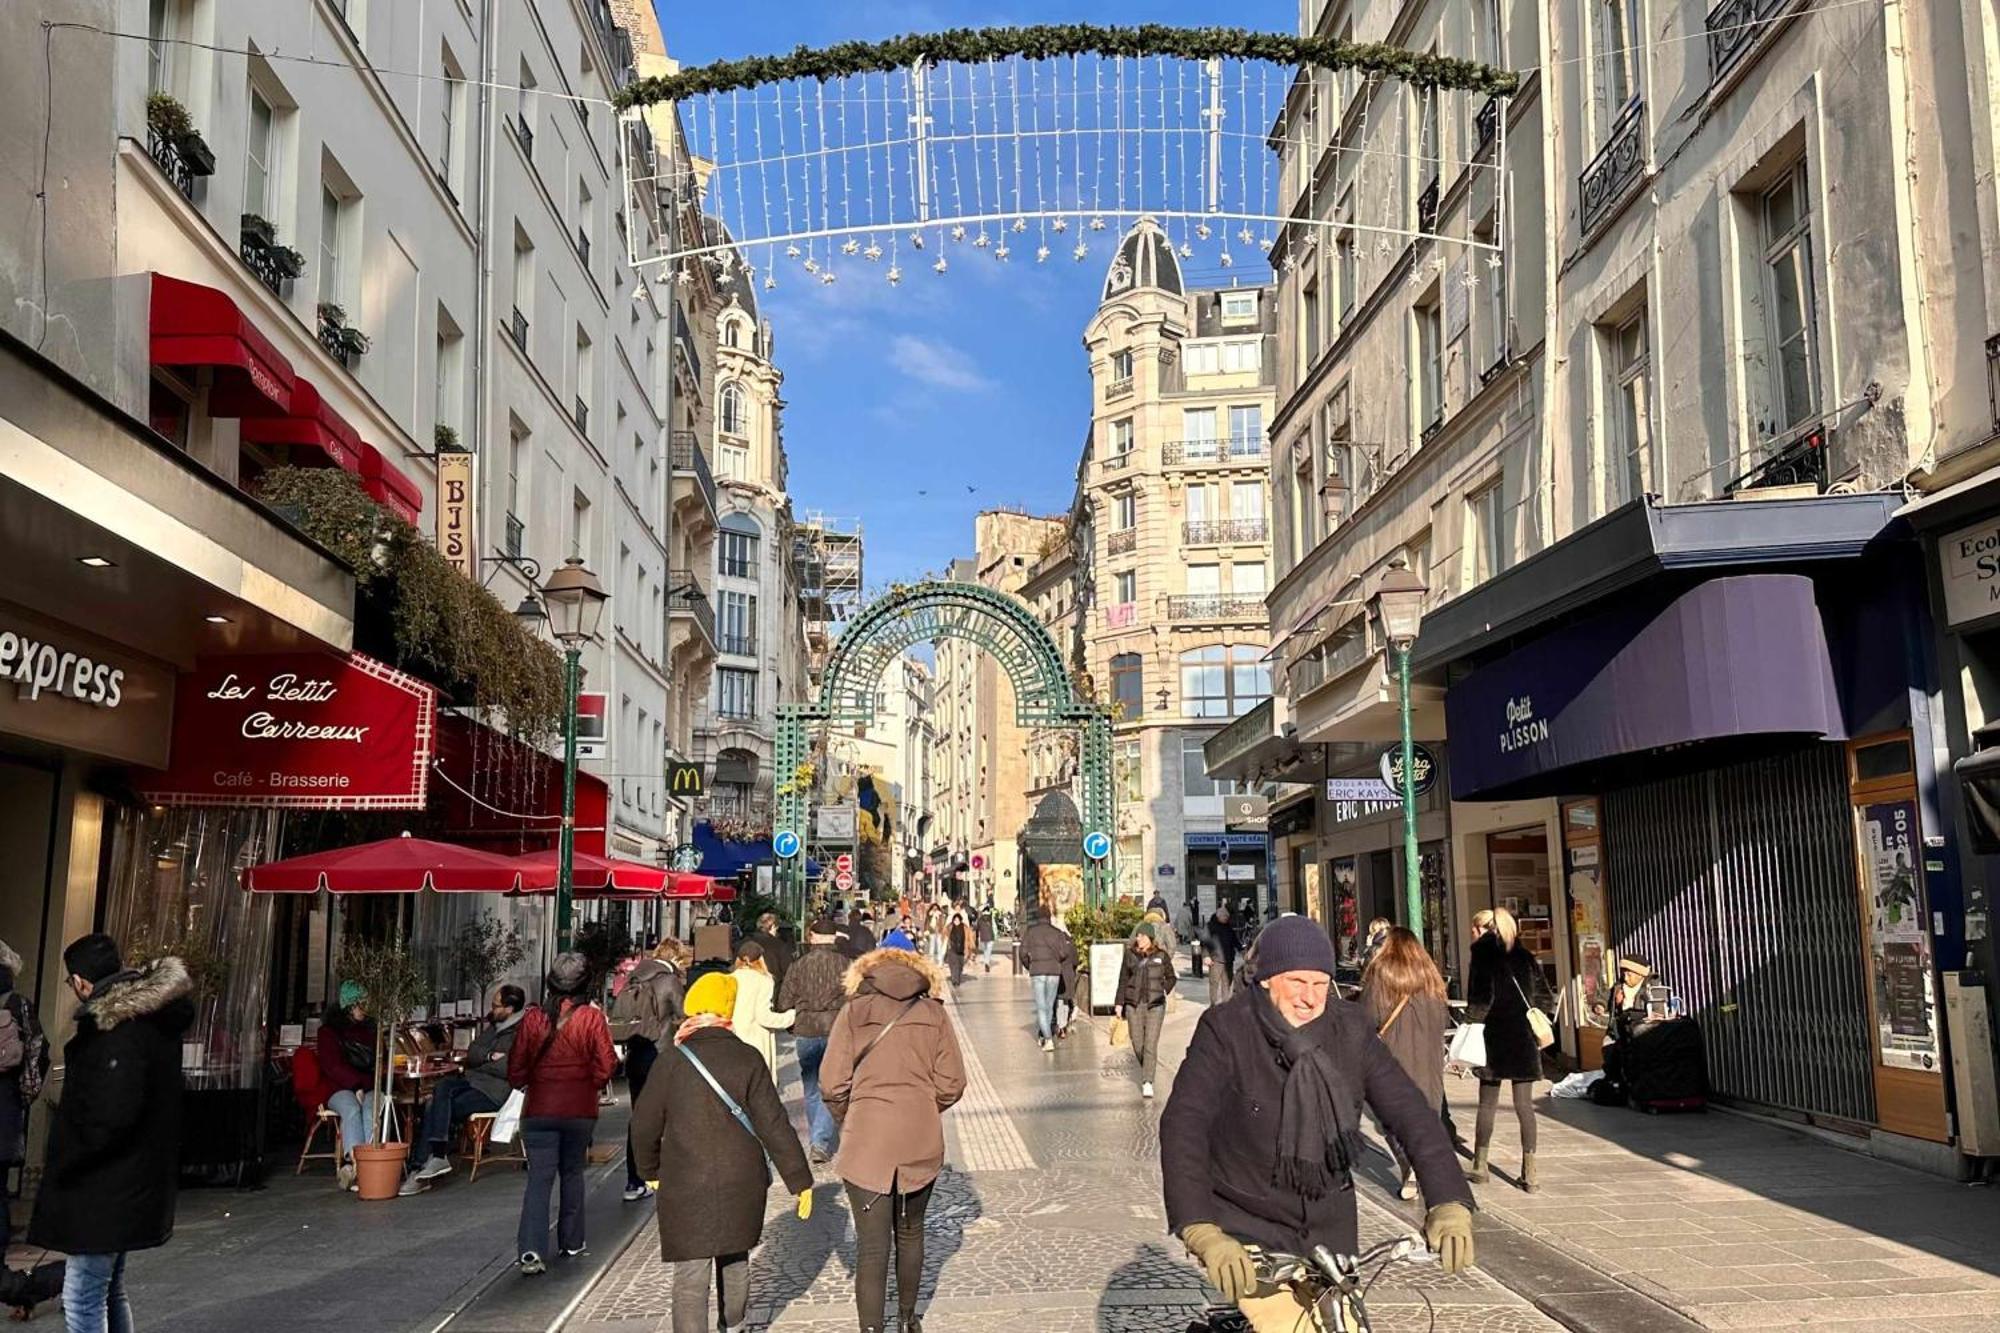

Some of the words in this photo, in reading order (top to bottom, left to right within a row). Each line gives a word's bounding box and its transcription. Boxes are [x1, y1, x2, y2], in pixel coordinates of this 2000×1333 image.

[0, 631, 124, 707] express
[207, 674, 256, 699] Les
[267, 673, 338, 701] Petits
[242, 711, 369, 743] Carreaux
[1506, 695, 1533, 729] Petit
[1499, 717, 1549, 754] PLISSON
[213, 771, 253, 786] Café
[269, 771, 350, 787] Brasserie
[1328, 789, 1354, 798] ERIC
[1358, 788, 1399, 798] KAYSE
[1336, 801, 1358, 822] ERIC
[1364, 800, 1404, 815] KAYS
